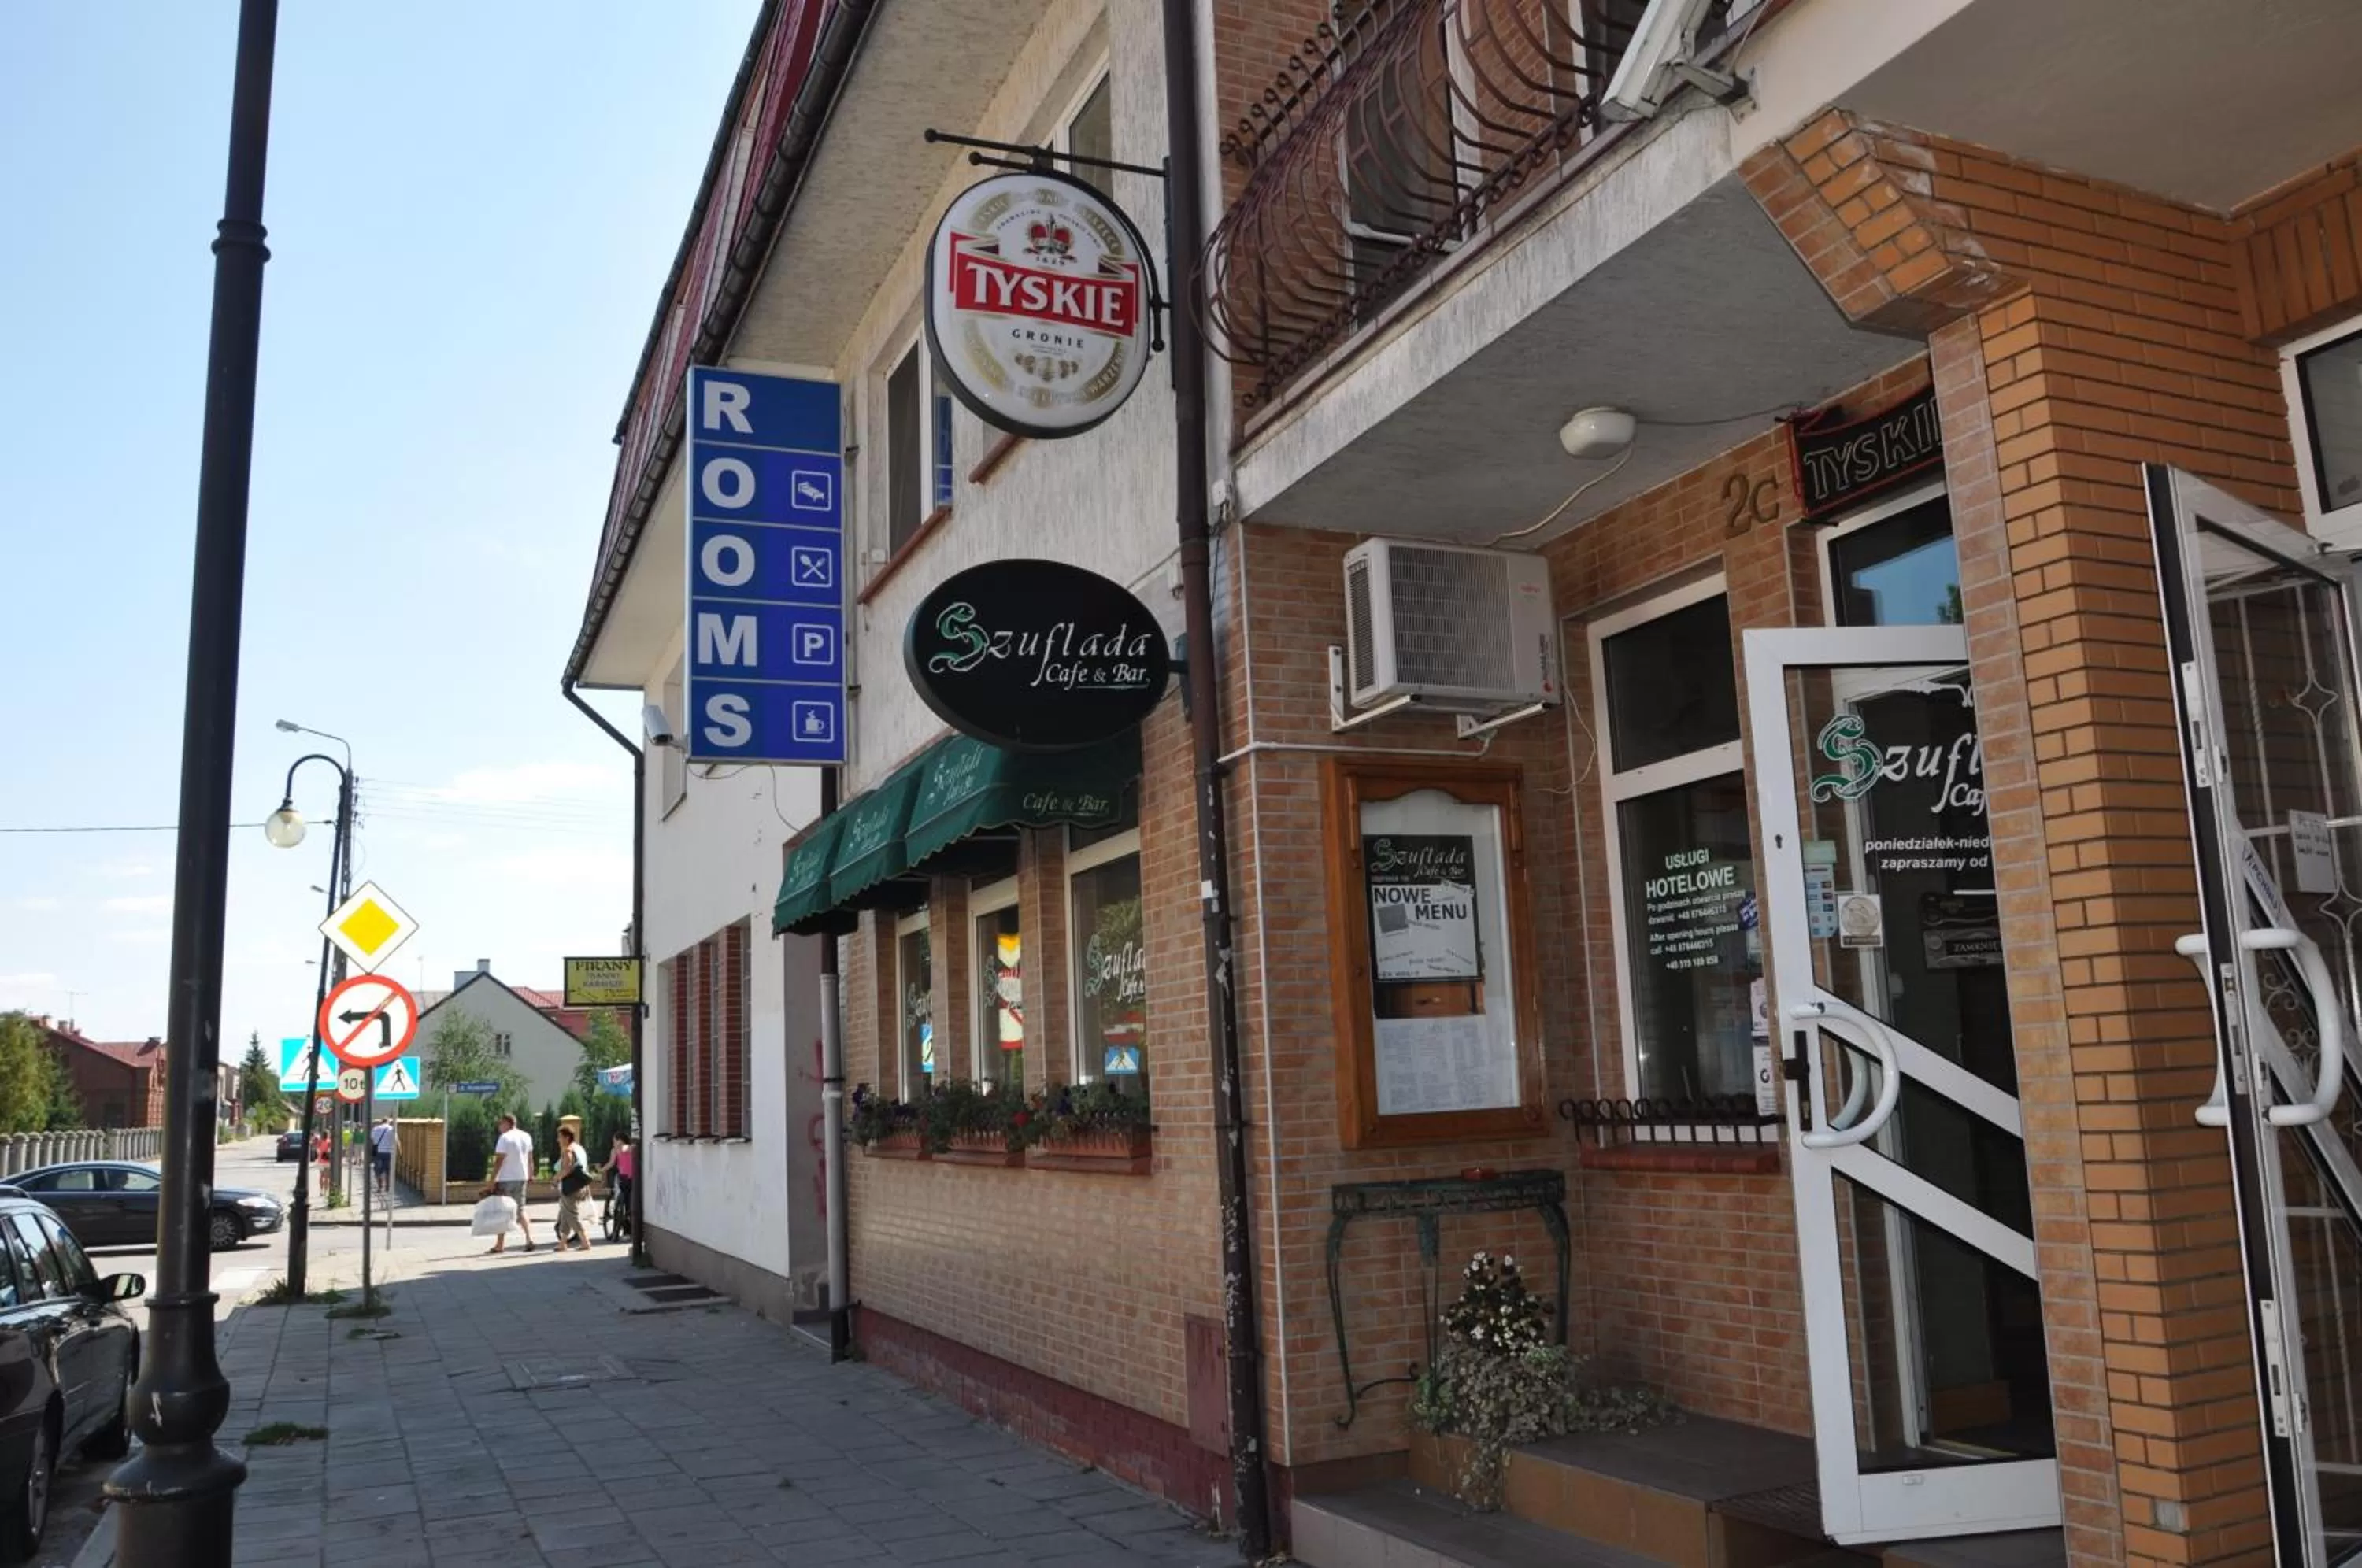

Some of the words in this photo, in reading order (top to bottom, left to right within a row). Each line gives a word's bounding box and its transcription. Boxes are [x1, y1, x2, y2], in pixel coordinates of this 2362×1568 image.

[965, 261, 1124, 327] TYSKIE
[1012, 328, 1084, 349] GRONIE
[698, 380, 757, 748] ROOMS
[803, 633, 824, 658] P
[929, 602, 1152, 687] Szuflada
[1046, 660, 1088, 690] Cafe
[1094, 666, 1107, 682] &
[1113, 664, 1149, 685] Bar
[1812, 714, 1981, 814] Szufl
[1023, 791, 1058, 816] Cafe
[1078, 794, 1109, 812] Bar
[1949, 782, 1985, 816] Caf
[1371, 838, 1464, 878] Szuflada
[1864, 834, 1990, 853] poniedziałek-nied
[1880, 857, 1966, 871] zapraszamy
[1969, 854, 1988, 868] od
[1374, 887, 1431, 904] NOWE
[1646, 866, 1734, 898] HOTELOWE
[1415, 904, 1468, 920] MENU
